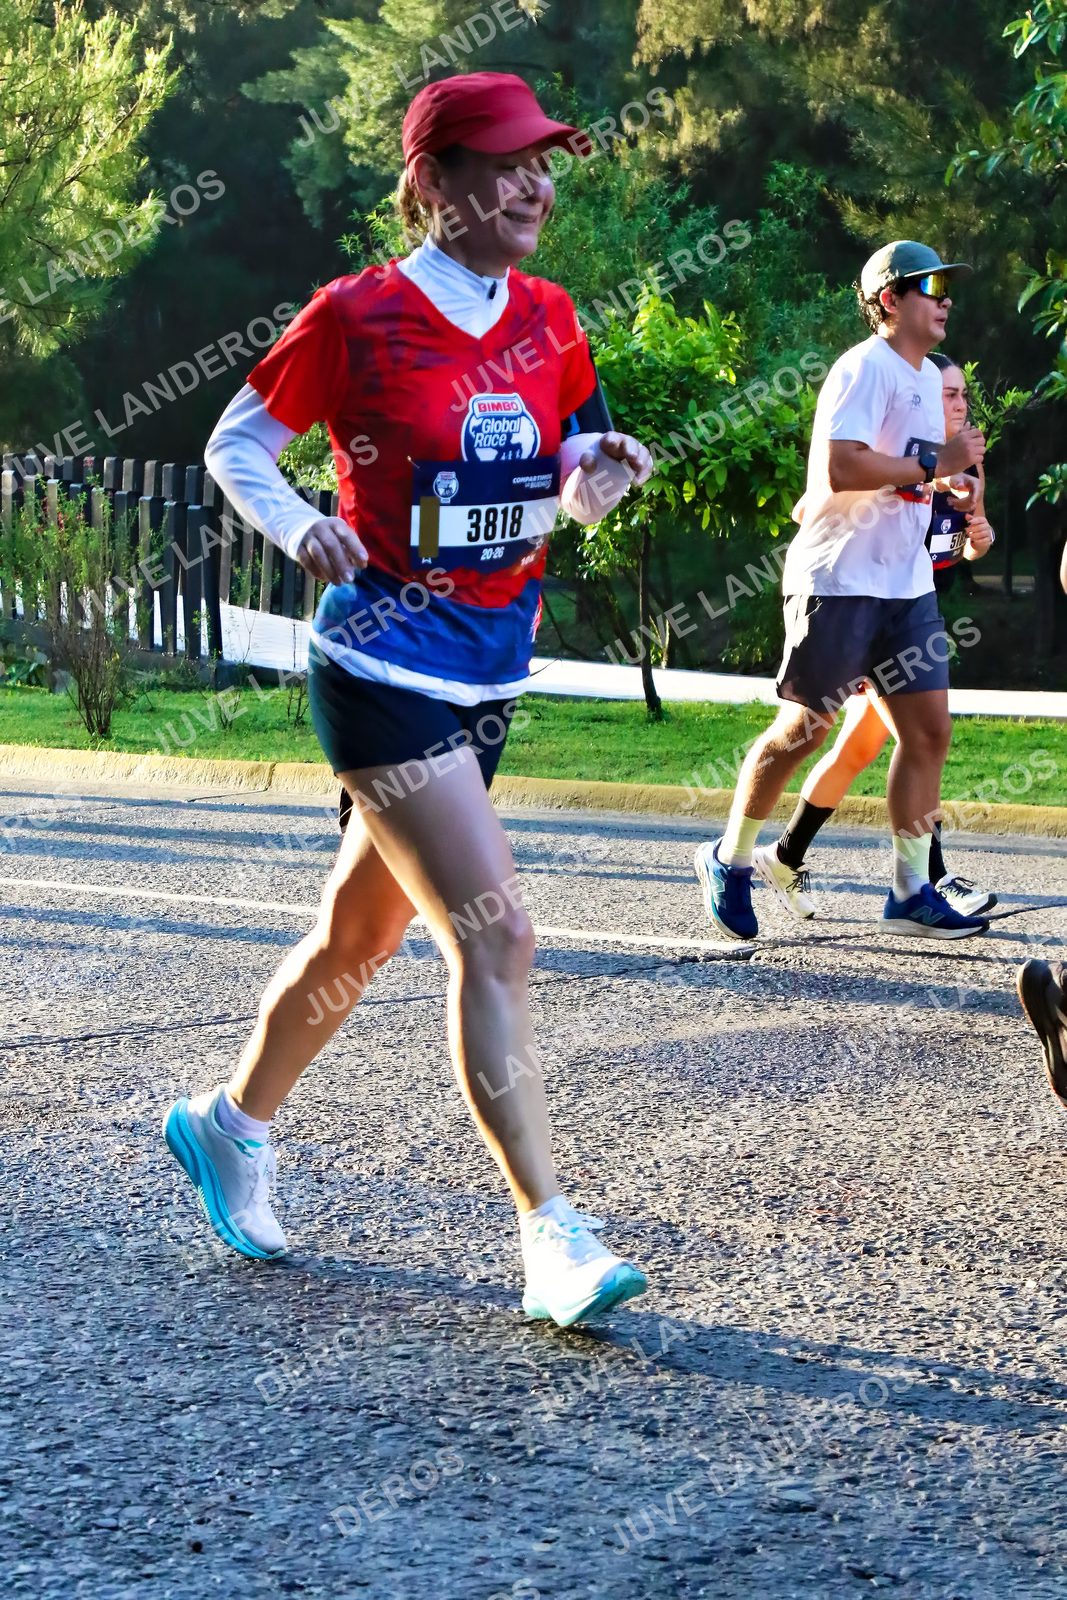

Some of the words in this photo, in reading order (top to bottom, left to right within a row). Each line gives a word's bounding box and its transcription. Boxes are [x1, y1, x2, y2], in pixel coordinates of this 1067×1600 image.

[478, 401, 519, 412] BIMBO
[481, 417, 520, 434] Global
[474, 432, 507, 448] Race
[466, 504, 524, 543] 3818
